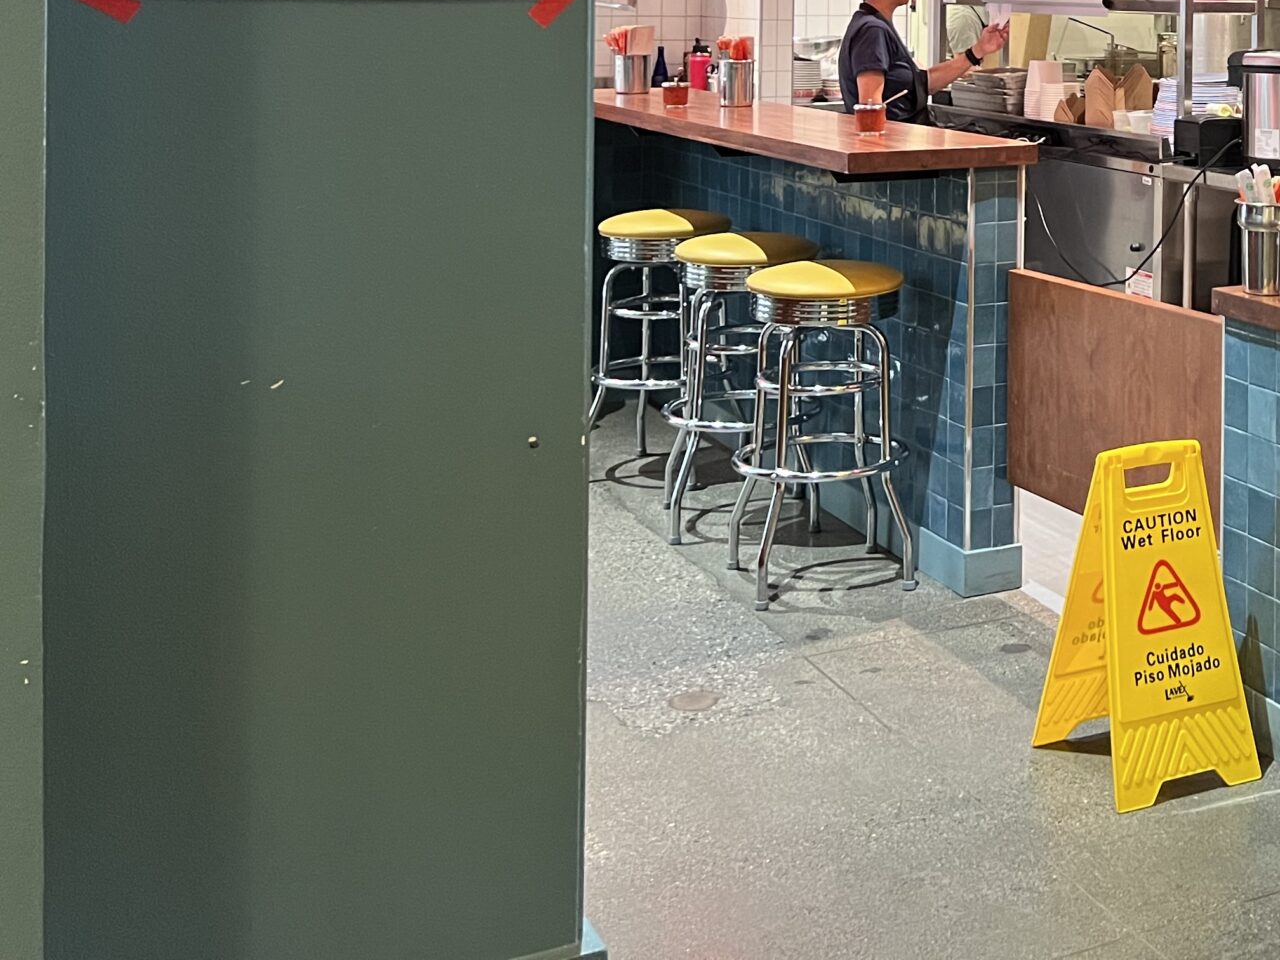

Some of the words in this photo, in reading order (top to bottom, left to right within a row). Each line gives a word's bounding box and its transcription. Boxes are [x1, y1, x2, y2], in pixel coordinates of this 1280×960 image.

[1123, 508, 1197, 534] CAUTION
[1121, 533, 1153, 550] Wet
[1162, 526, 1202, 543] Floor
[1146, 642, 1205, 666] Cuidado
[1134, 668, 1164, 686] Piso
[1168, 656, 1221, 679] Mojado
